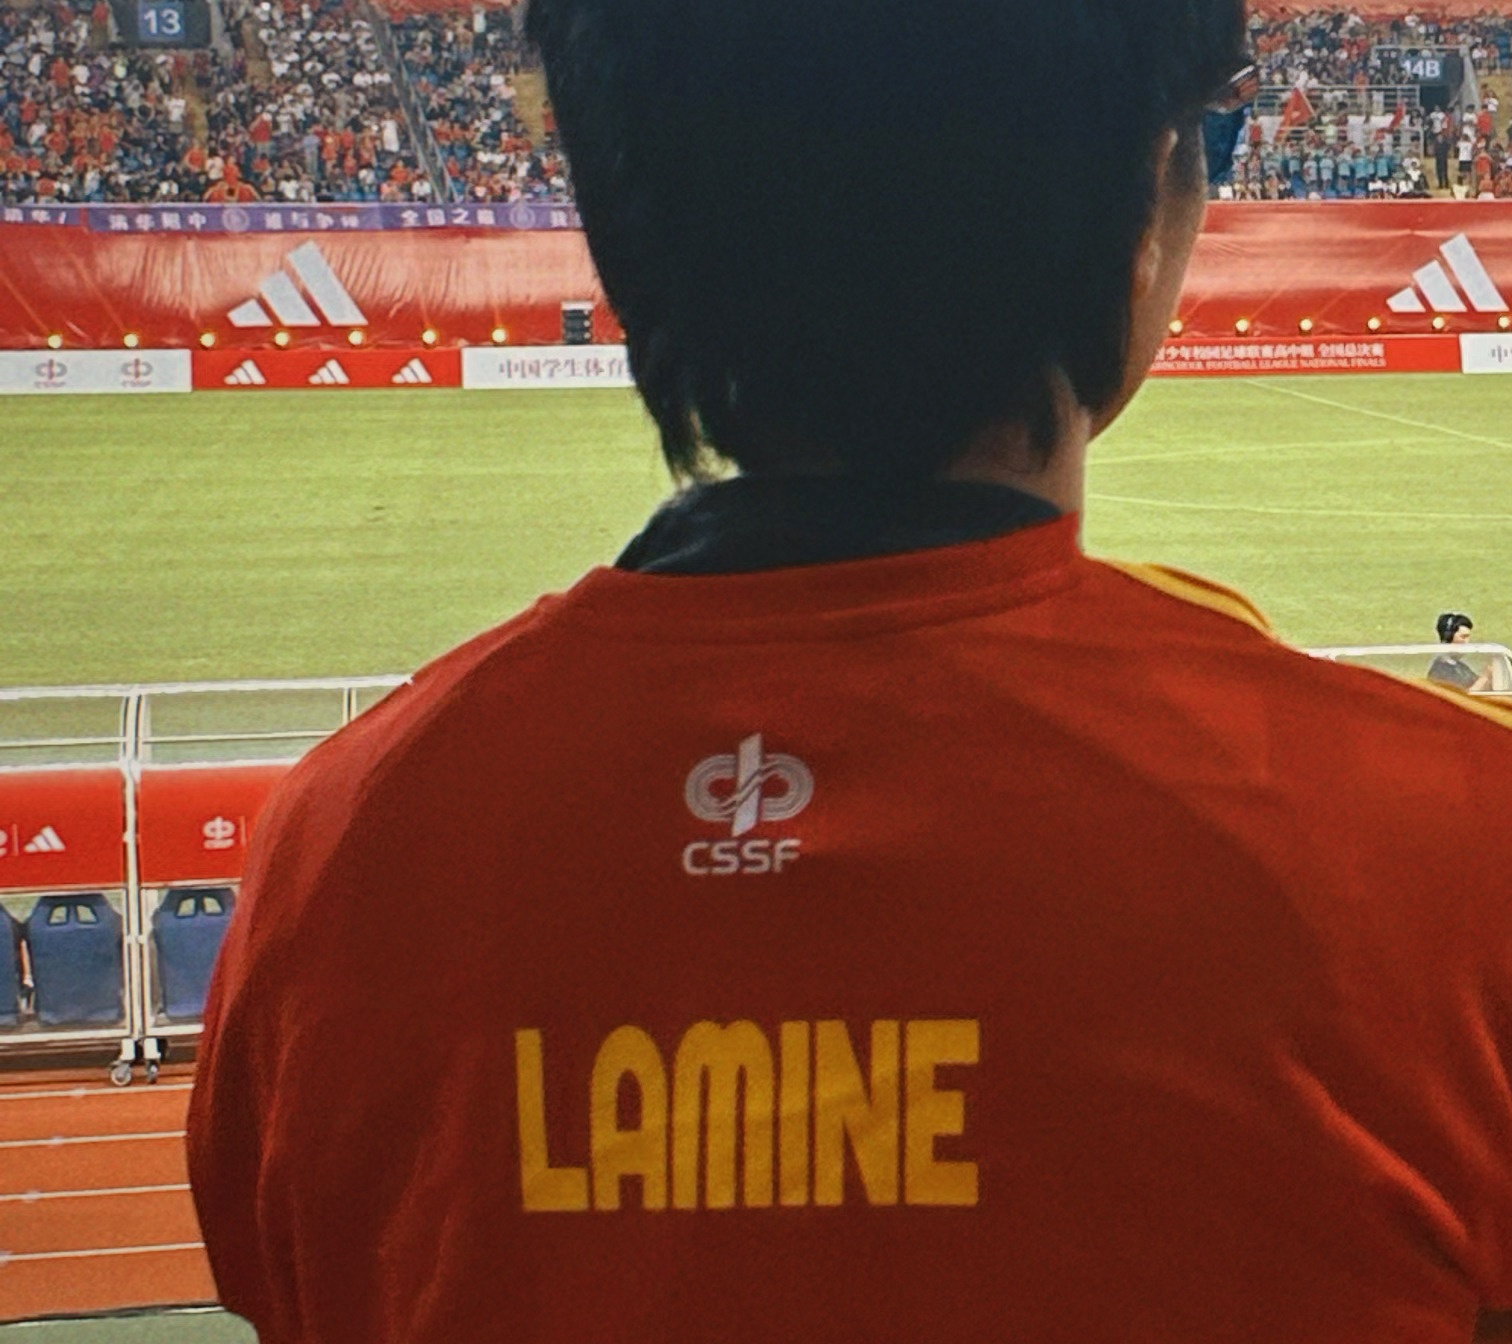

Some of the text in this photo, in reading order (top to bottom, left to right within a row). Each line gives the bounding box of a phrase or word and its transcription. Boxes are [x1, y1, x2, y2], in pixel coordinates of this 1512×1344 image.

[143, 8, 181, 35] 13
[682, 837, 802, 875] CSSF
[515, 1018, 980, 1212] LAMINE
